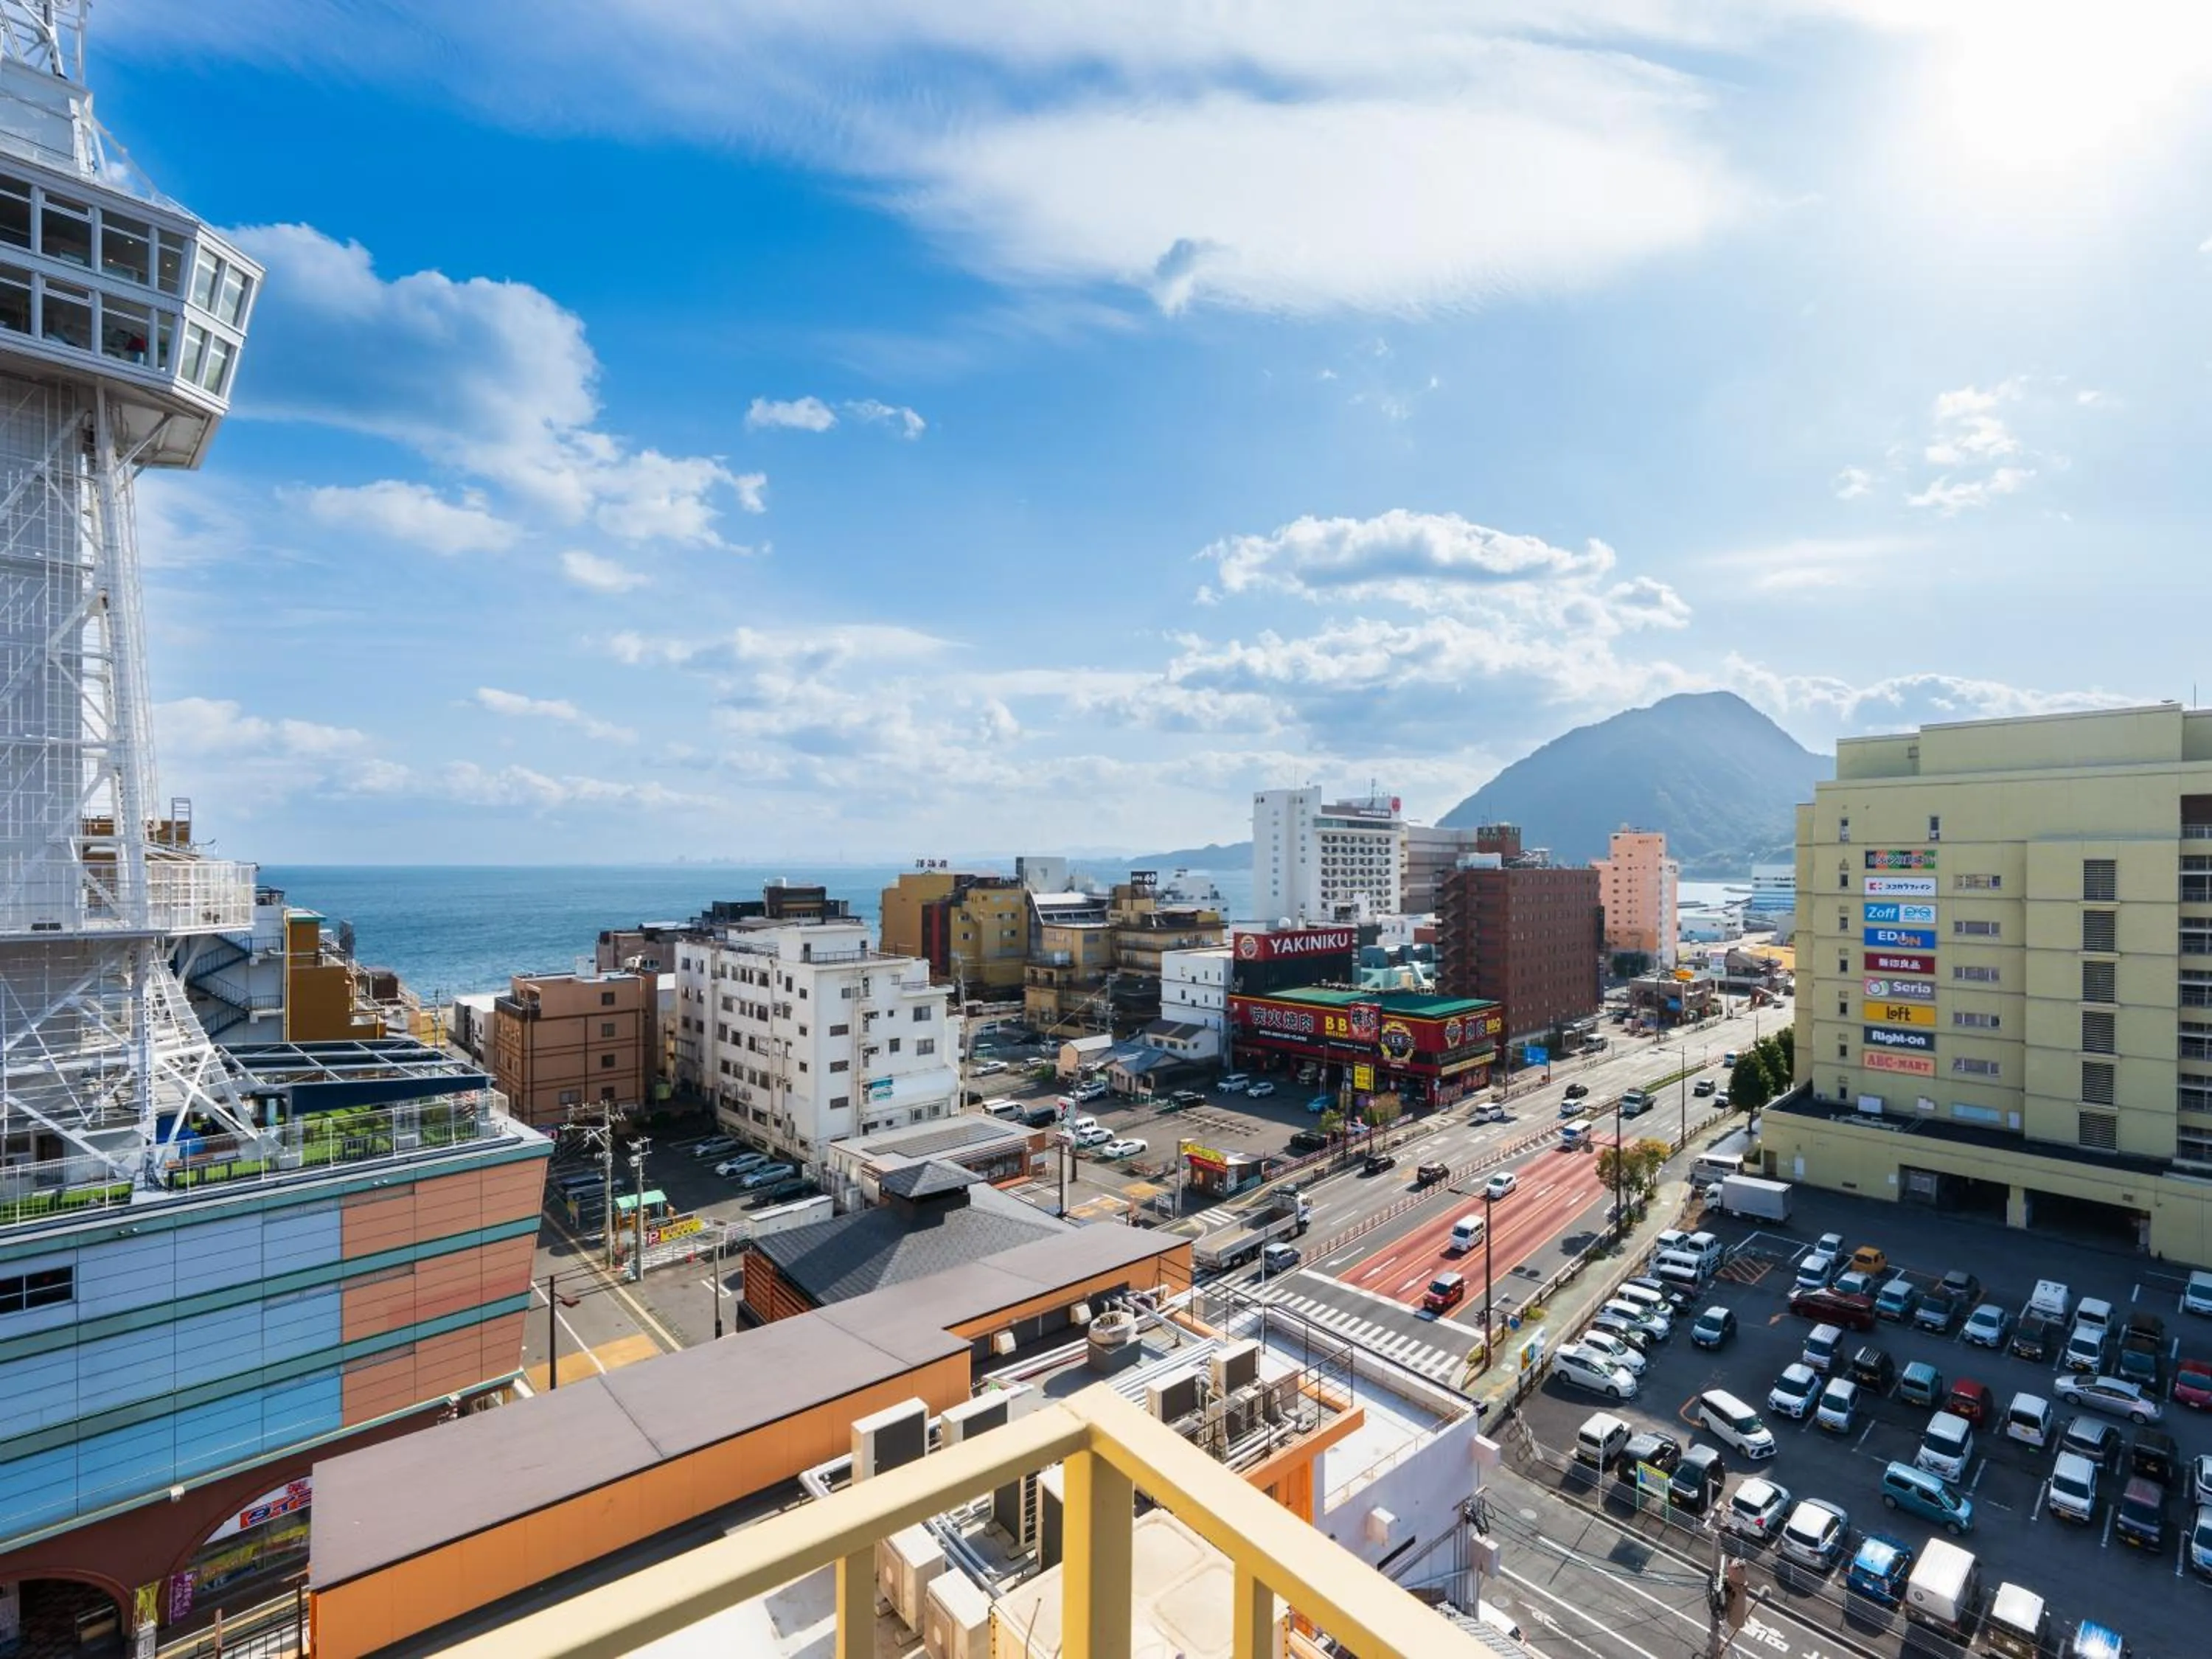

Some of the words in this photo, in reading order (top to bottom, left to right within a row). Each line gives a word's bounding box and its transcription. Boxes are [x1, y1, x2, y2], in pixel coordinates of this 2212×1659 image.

[1868, 906, 1896, 919] Zoff
[1270, 933, 1349, 955] YAKINIKU
[1893, 981, 1931, 993] Seria
[1872, 1031, 1925, 1046] Right-on
[1867, 1054, 1930, 1071] ABC-MART
